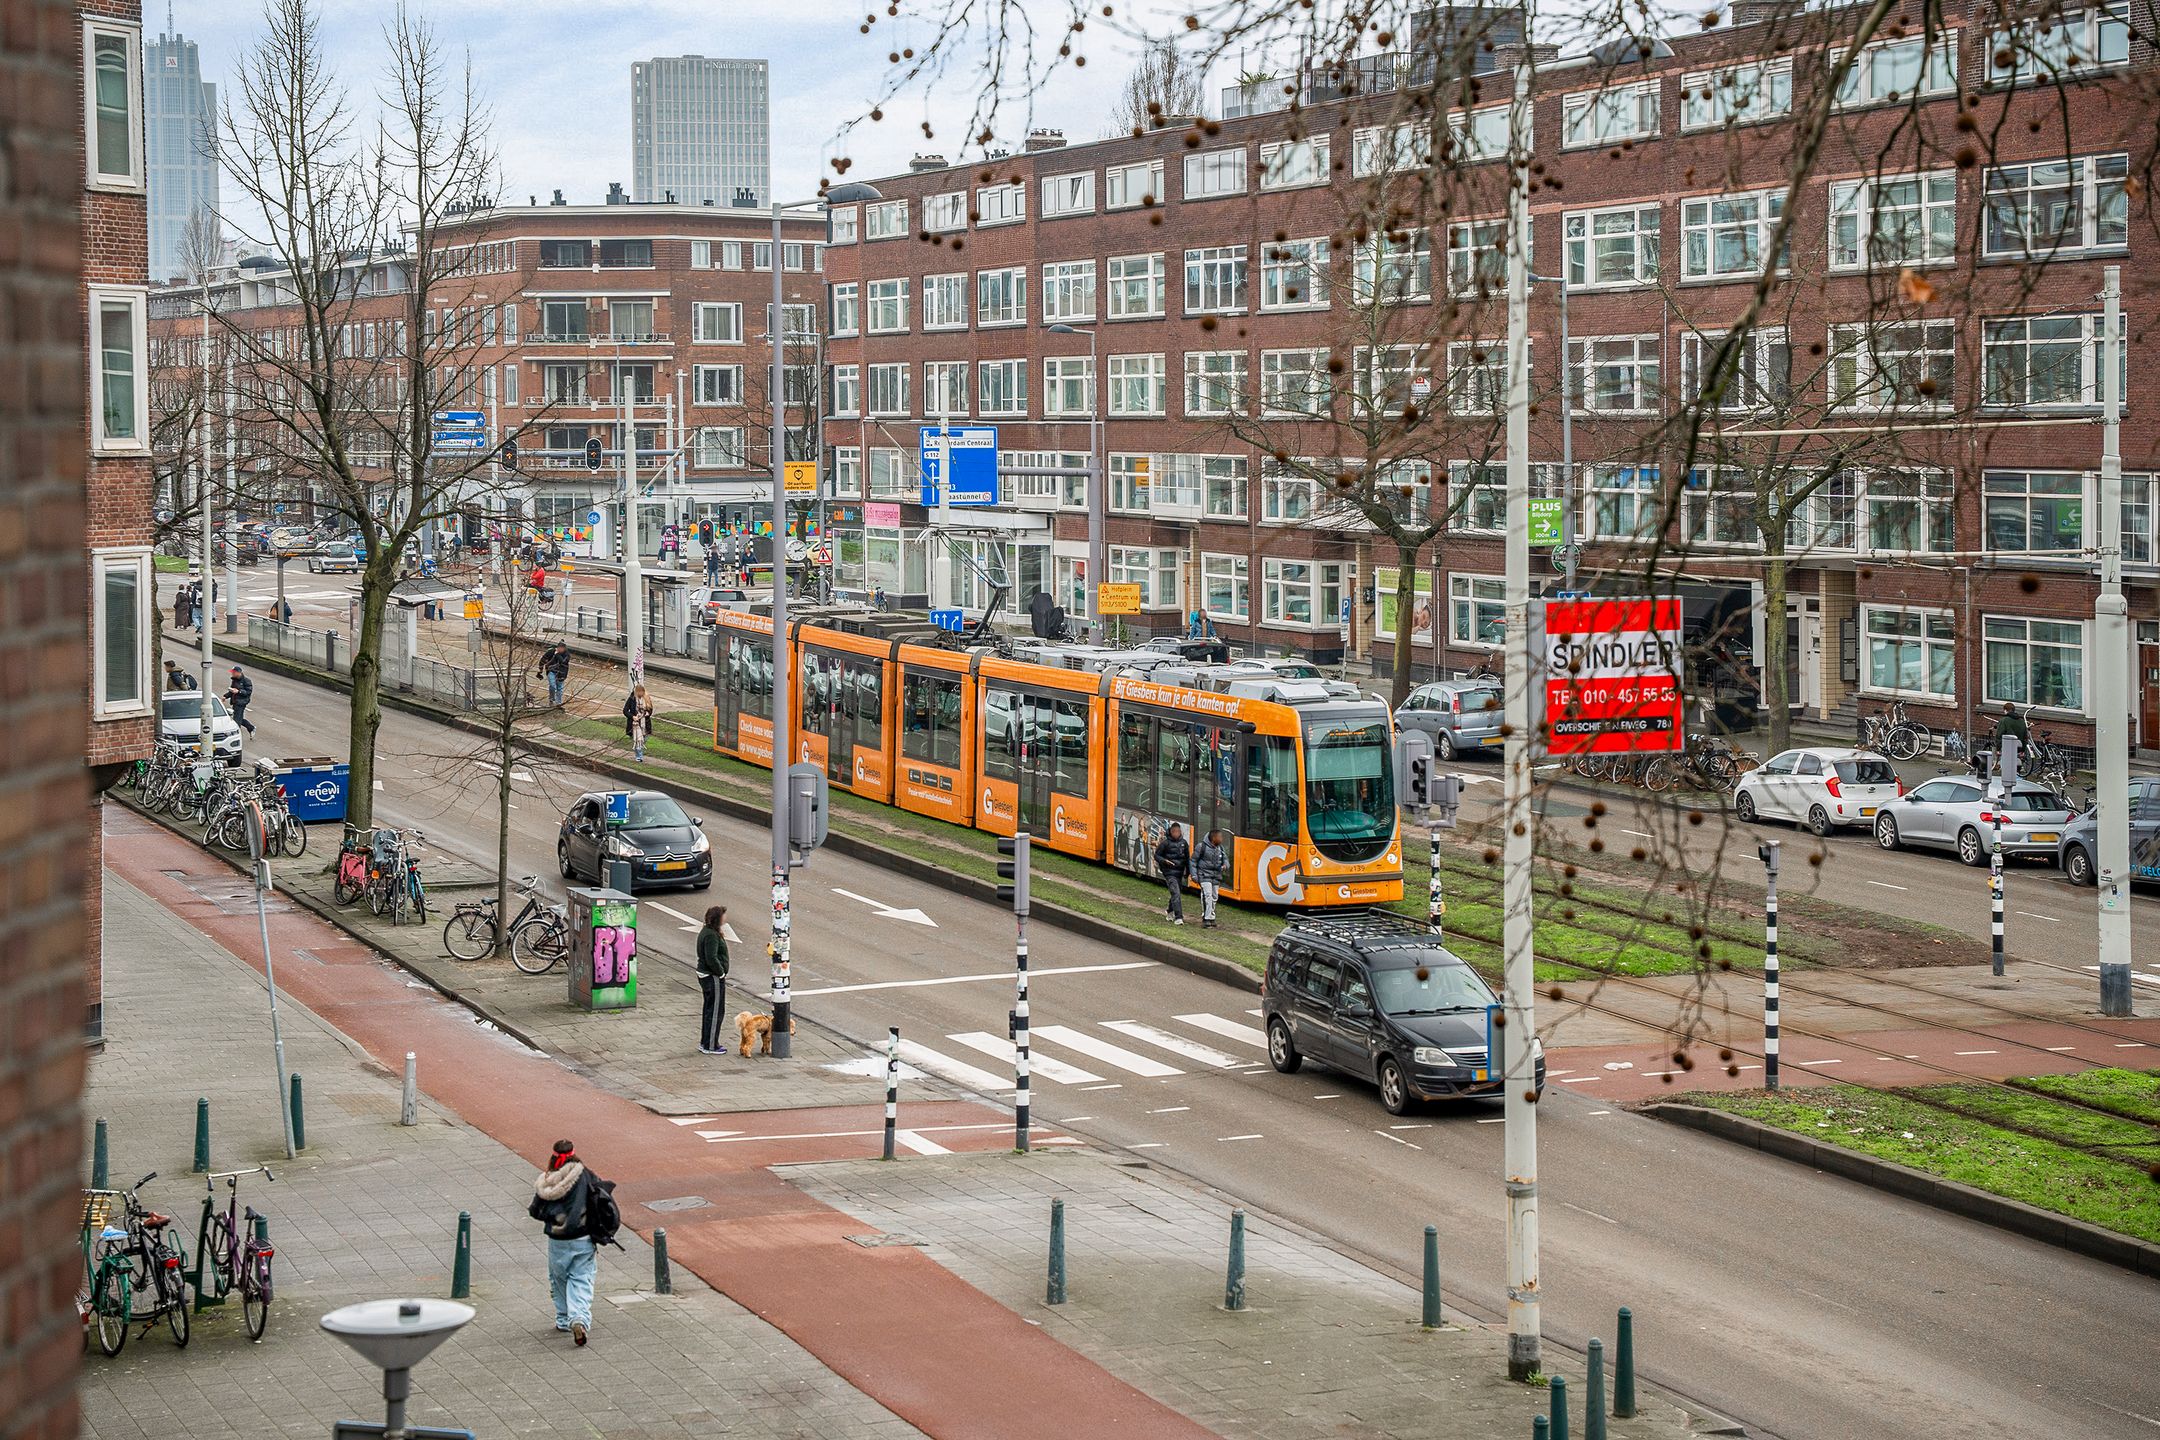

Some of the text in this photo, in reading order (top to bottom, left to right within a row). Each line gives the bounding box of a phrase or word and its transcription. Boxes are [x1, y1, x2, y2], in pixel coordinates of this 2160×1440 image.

[1531, 502, 1561, 512] PLUS
[1553, 640, 1674, 670] SPINDLER
[1115, 680, 1240, 717] Bij Giesbers kun je alle kanten op!
[1584, 689, 1607, 704] 010
[1643, 687, 1658, 702] 55
[304, 784, 340, 797] renewi
[1352, 887, 1378, 896] Giesbers
